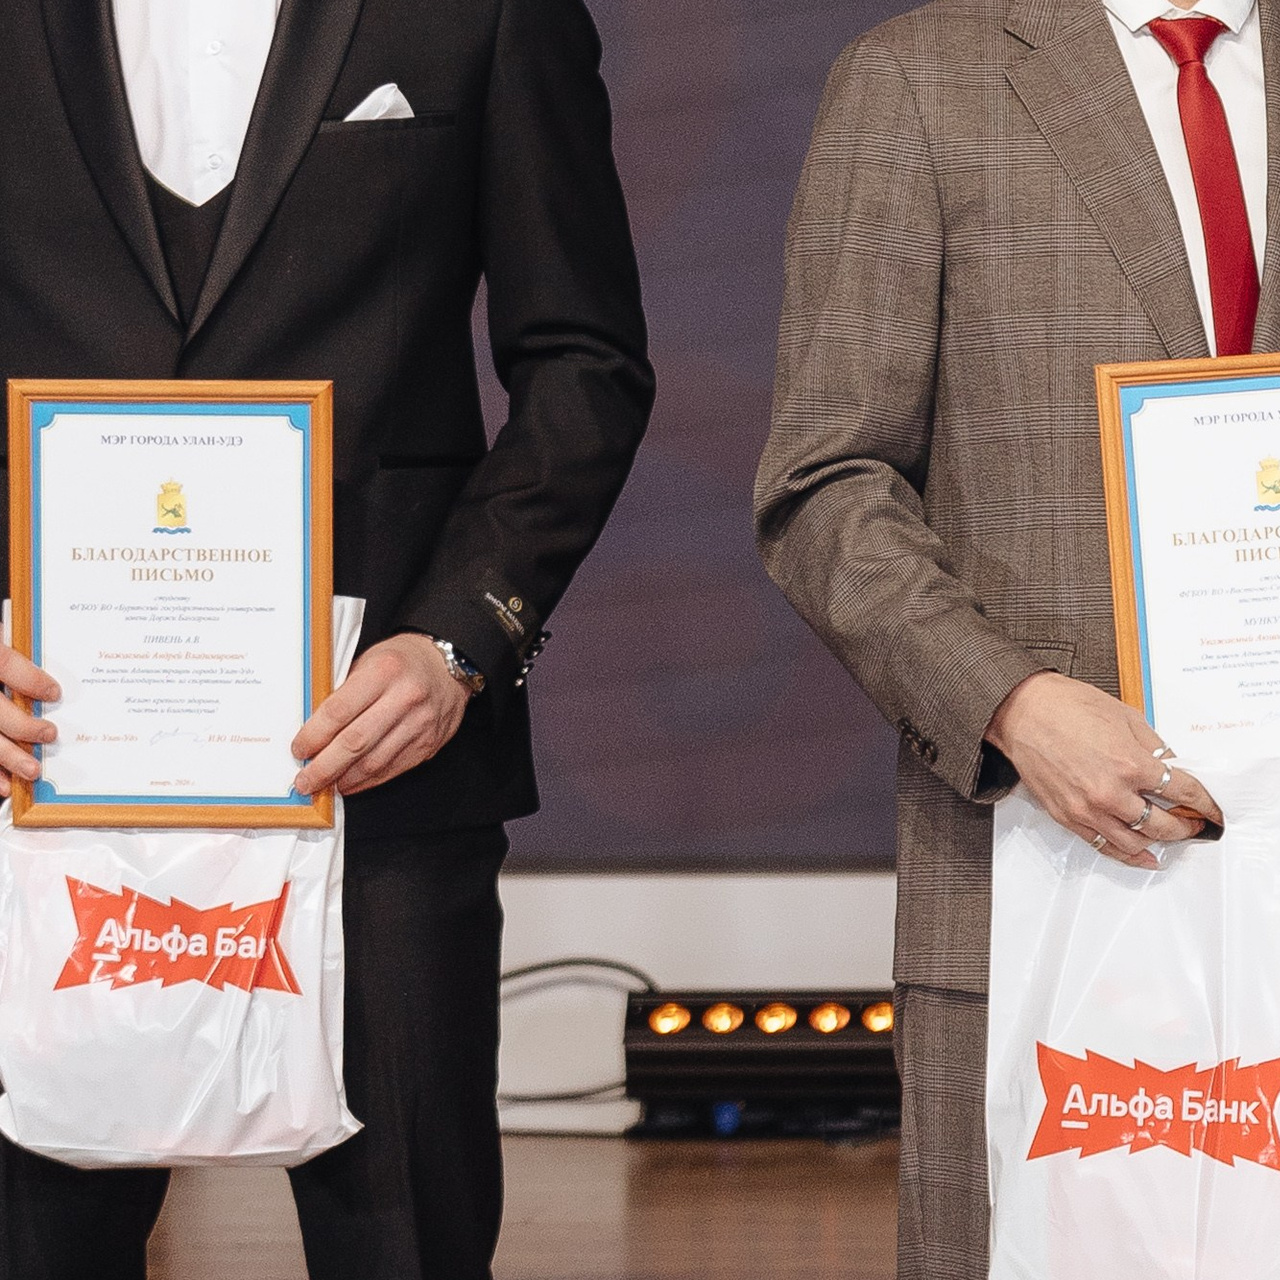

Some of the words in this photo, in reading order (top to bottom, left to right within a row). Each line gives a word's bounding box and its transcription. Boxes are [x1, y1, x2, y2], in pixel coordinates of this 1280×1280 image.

[1194, 415, 1220, 427] МЭР
[1224, 410, 1274, 424] ГОРОДА
[101, 435, 127, 446] МЭР
[131, 435, 179, 446] ГОРОДА
[183, 435, 243, 447] УЛАН-УДЭ
[71, 547, 273, 564] БЛАГОДАРСТВЕННОЕ
[131, 568, 215, 583] ПИСЬМО
[95, 918, 208, 961] Альфа
[1062, 1084, 1174, 1126] Альфа
[1181, 1090, 1260, 1125] Банк
